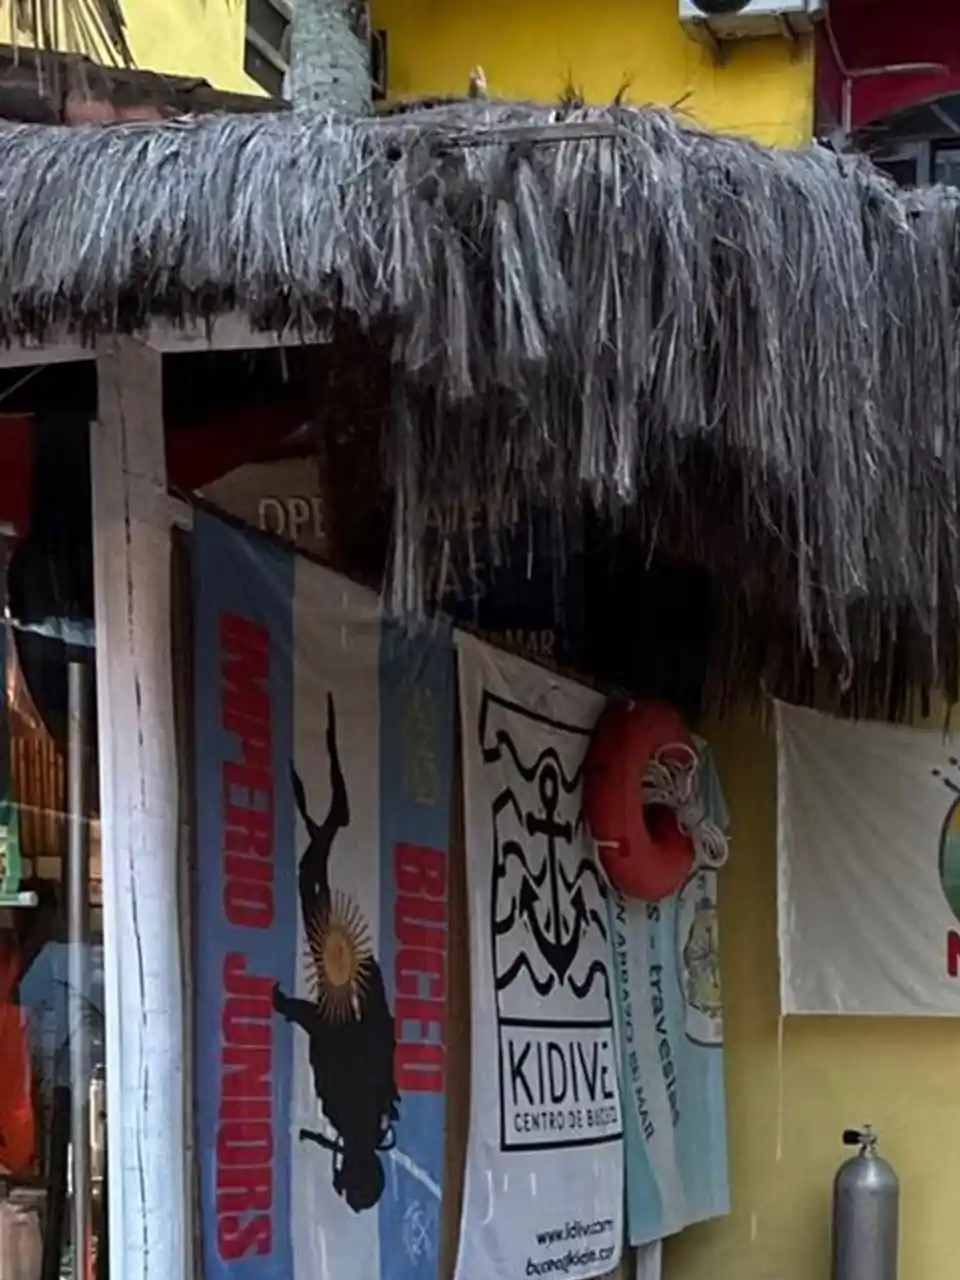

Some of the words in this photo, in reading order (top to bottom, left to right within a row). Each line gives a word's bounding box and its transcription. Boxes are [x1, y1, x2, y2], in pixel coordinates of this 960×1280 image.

[220, 609, 276, 929] IMPERIO
[393, 841, 448, 1093] BUCEO
[507, 1038, 615, 1106] KIDIVE
[216, 952, 276, 1262] JUNIORS
[514, 1108, 565, 1134] CENTRO
[567, 1108, 584, 1130] DE
